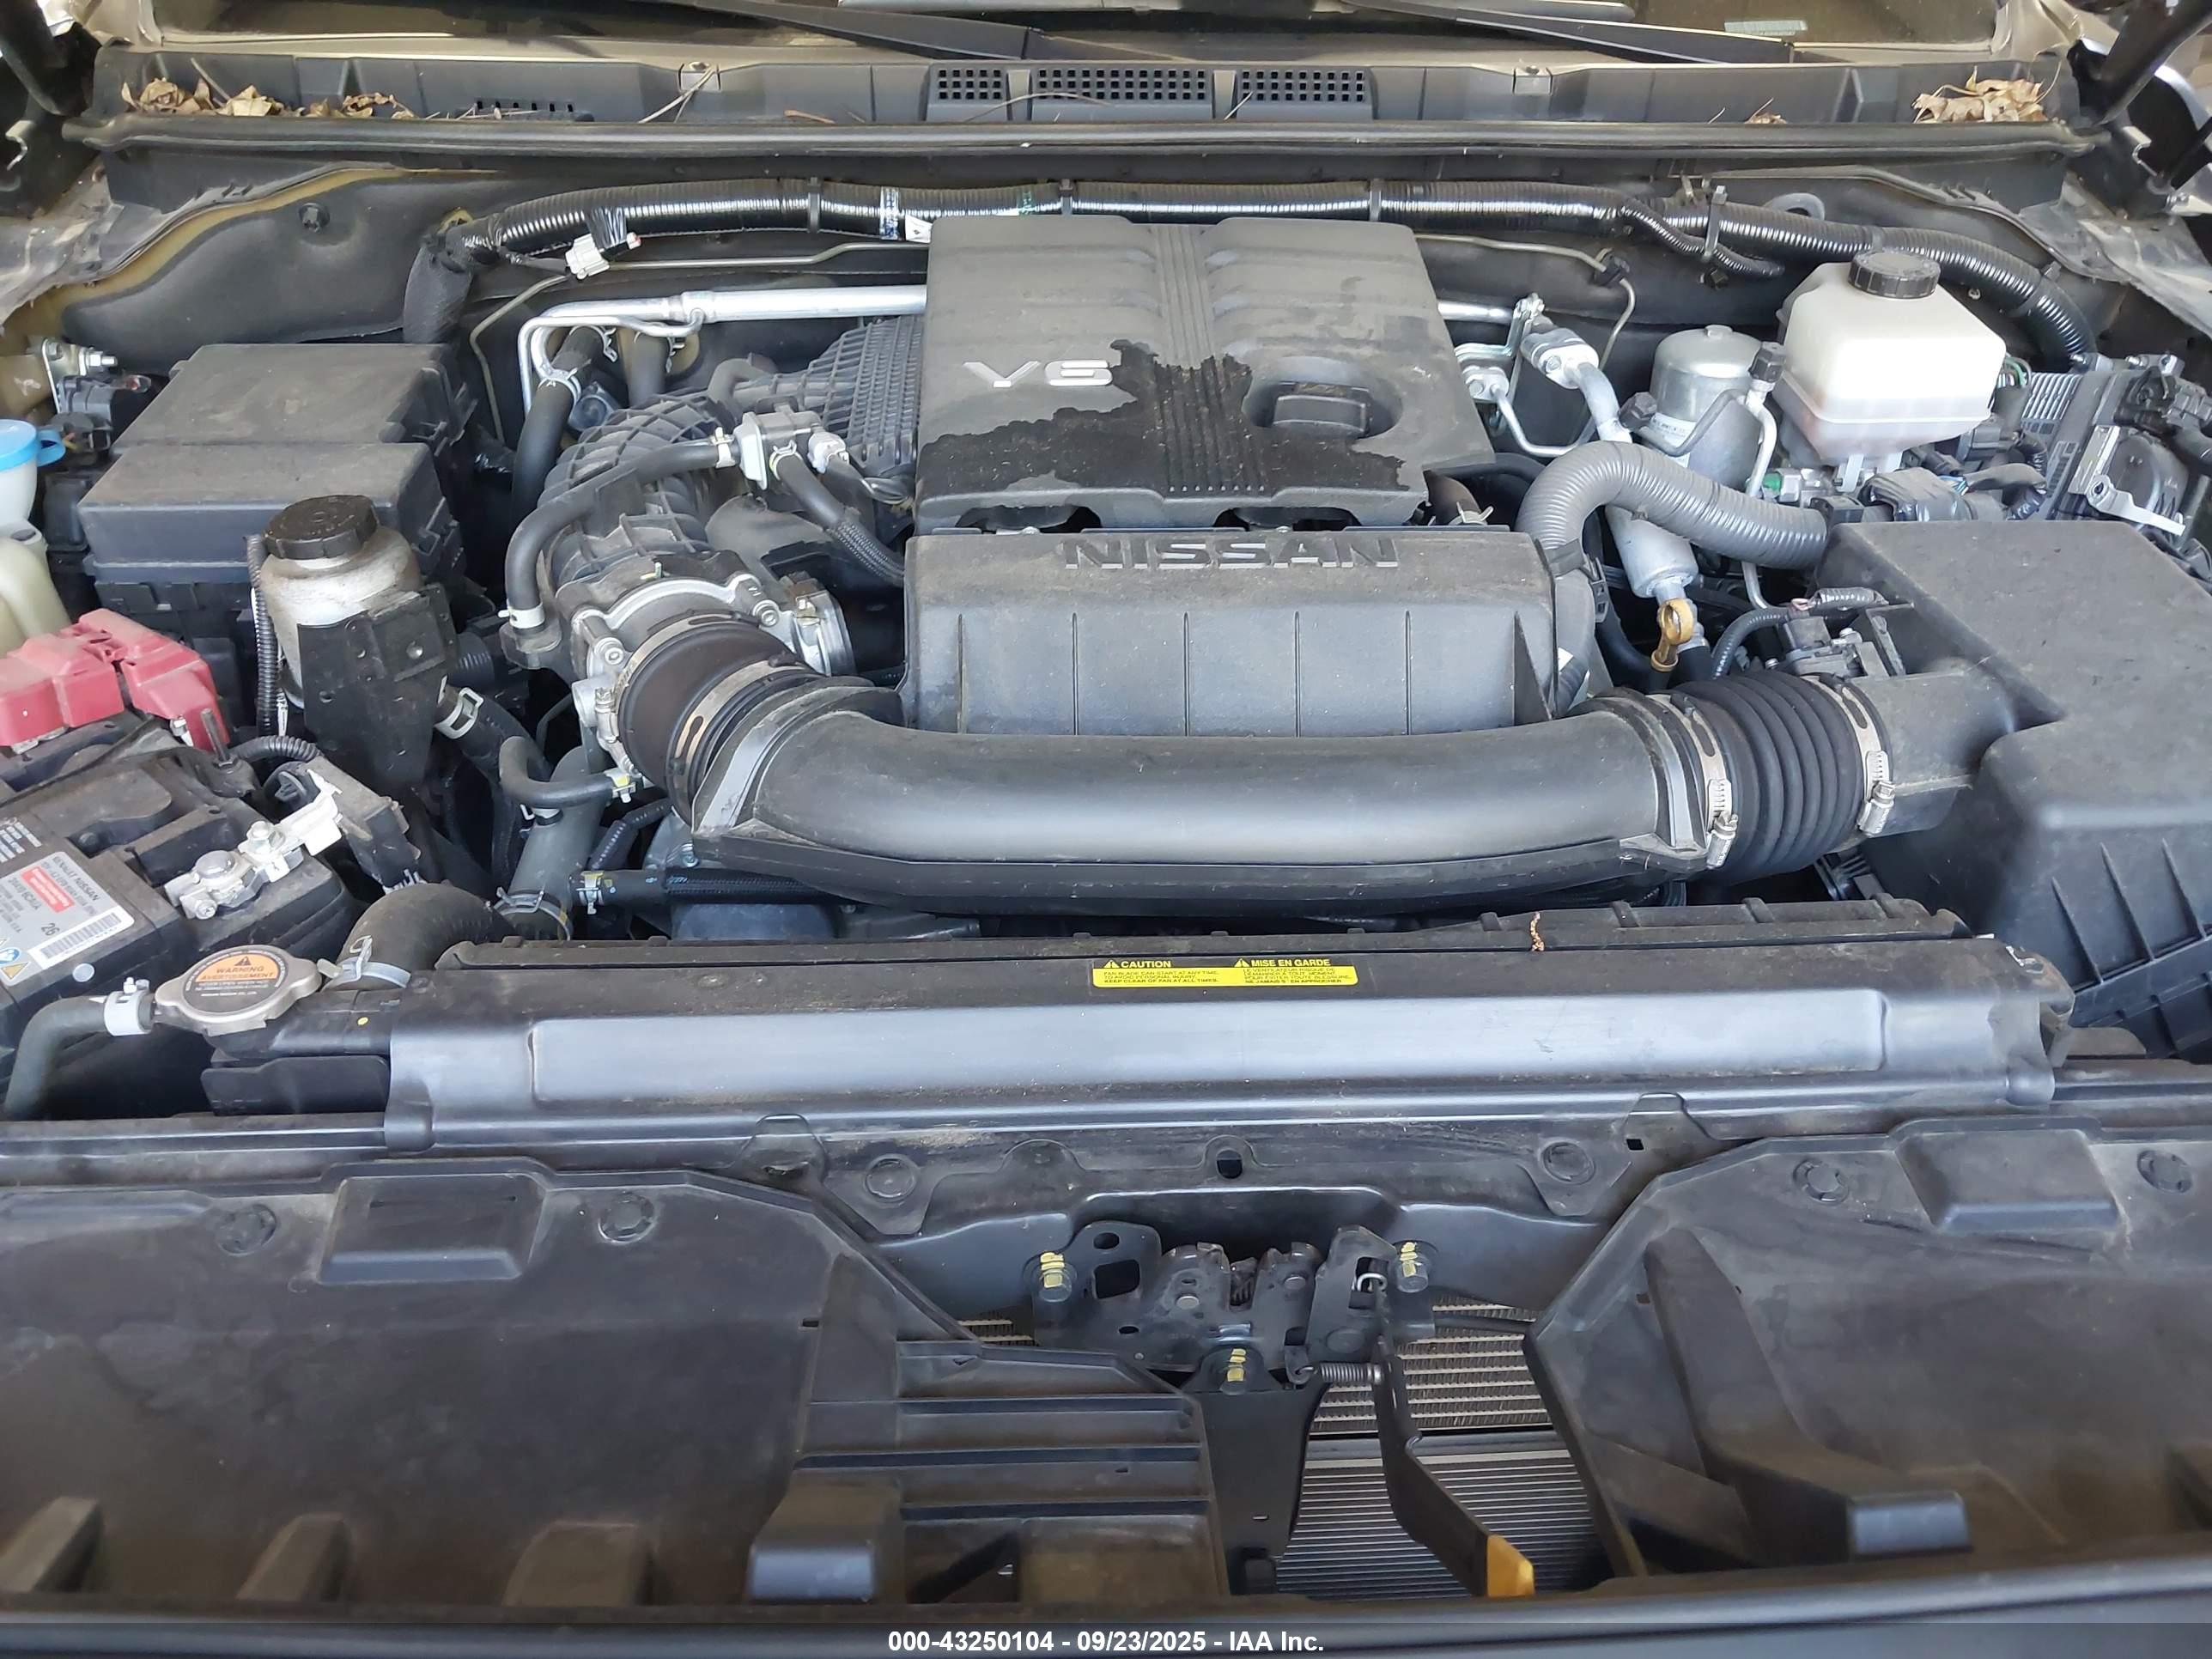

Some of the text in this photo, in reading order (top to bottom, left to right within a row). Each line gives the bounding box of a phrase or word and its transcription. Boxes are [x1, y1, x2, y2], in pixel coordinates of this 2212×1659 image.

[963, 359, 1113, 387] V6
[1061, 537, 1399, 568] NISSAN
[40, 922, 60, 936] 26
[216, 965, 264, 974] WARNING
[1121, 960, 1171, 969] CAUTION
